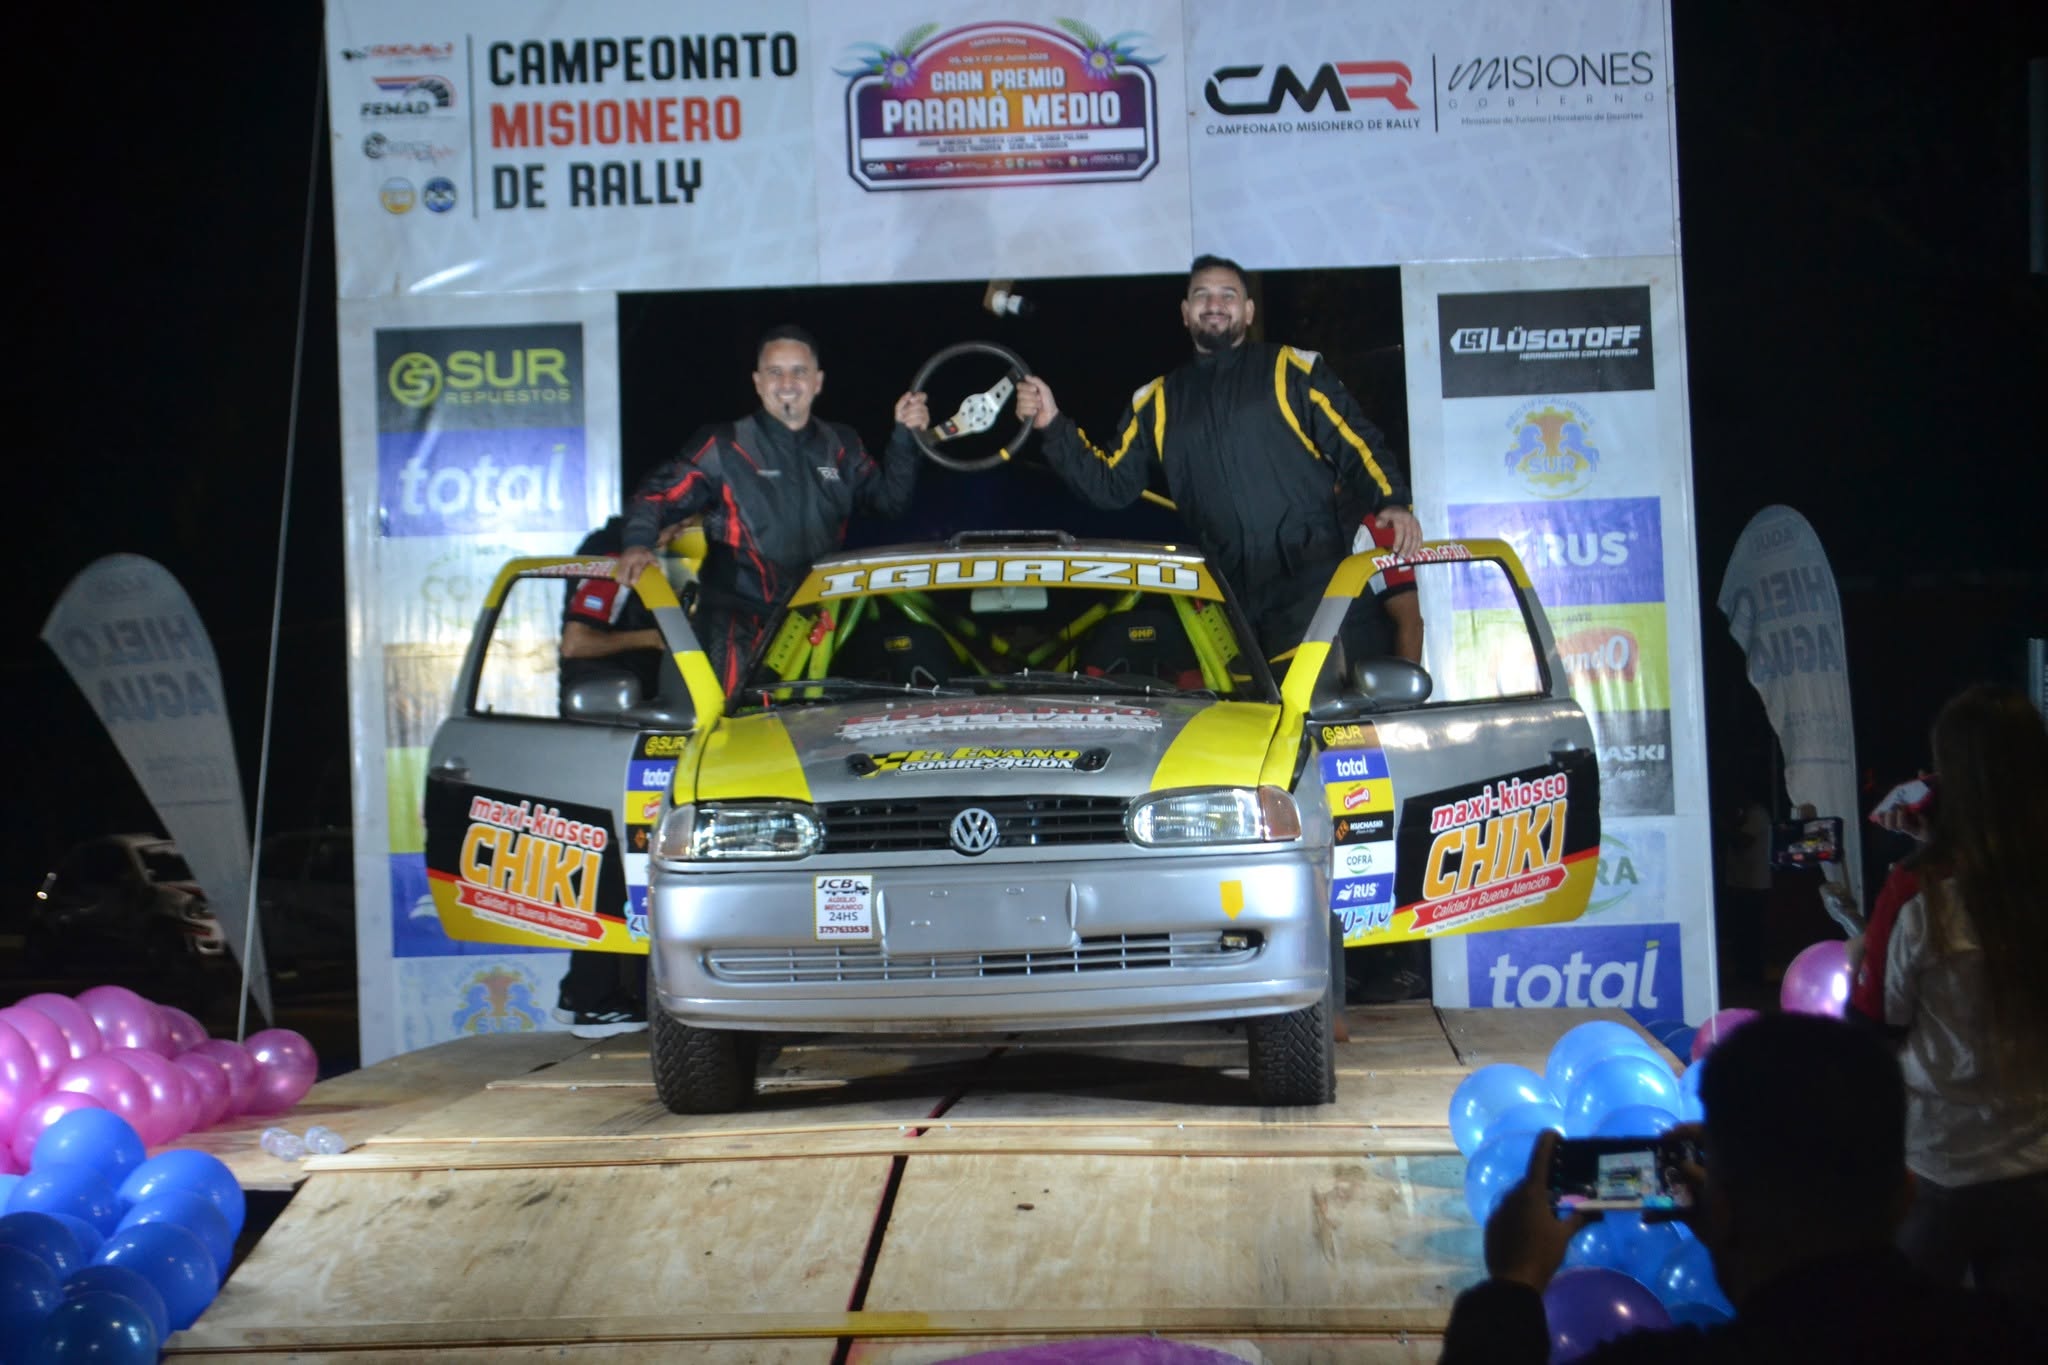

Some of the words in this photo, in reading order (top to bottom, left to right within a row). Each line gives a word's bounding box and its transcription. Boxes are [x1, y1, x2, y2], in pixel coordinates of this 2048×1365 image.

[489, 32, 798, 87] CAMPEONATO
[931, 70, 983, 92] GRAN
[991, 66, 1065, 89] PREMIO
[1448, 51, 1654, 91] MISIONES
[1204, 60, 1420, 115] CMR
[490, 95, 743, 149] MISIONERO
[882, 89, 1009, 134] PARANÁ
[1022, 90, 1121, 127] MEDIO
[1206, 122, 1293, 136] CAMPEONATO
[1296, 120, 1364, 133] MISIONERO
[1368, 119, 1383, 129] DE
[1386, 118, 1420, 129] RALLY
[493, 164, 547, 210] DE
[570, 158, 702, 207] RALLY
[446, 348, 570, 388] SUR
[444, 388, 571, 404] REPUESTOS
[400, 443, 568, 516] total
[1528, 456, 1575, 473] SUR
[1537, 531, 1629, 569] RUS
[1334, 725, 1364, 740] SUR
[951, 747, 1081, 760] ENANO
[1336, 754, 1368, 777] total
[469, 795, 608, 850] maxi-kiosco
[1430, 773, 1567, 833] maxi-kiosco
[459, 822, 603, 917] CHIKI
[1346, 854, 1373, 866] COFRA
[1422, 798, 1567, 901] CHIKI
[818, 879, 853, 889] JCB
[1353, 882, 1377, 898] RUS
[1432, 896, 1469, 919] Calidad
[1470, 898, 1477, 911] y
[1479, 888, 1508, 905] Buena
[1509, 876, 1549, 896] Atención
[829, 911, 858, 921] 24HS
[1490, 940, 1660, 1009] total
